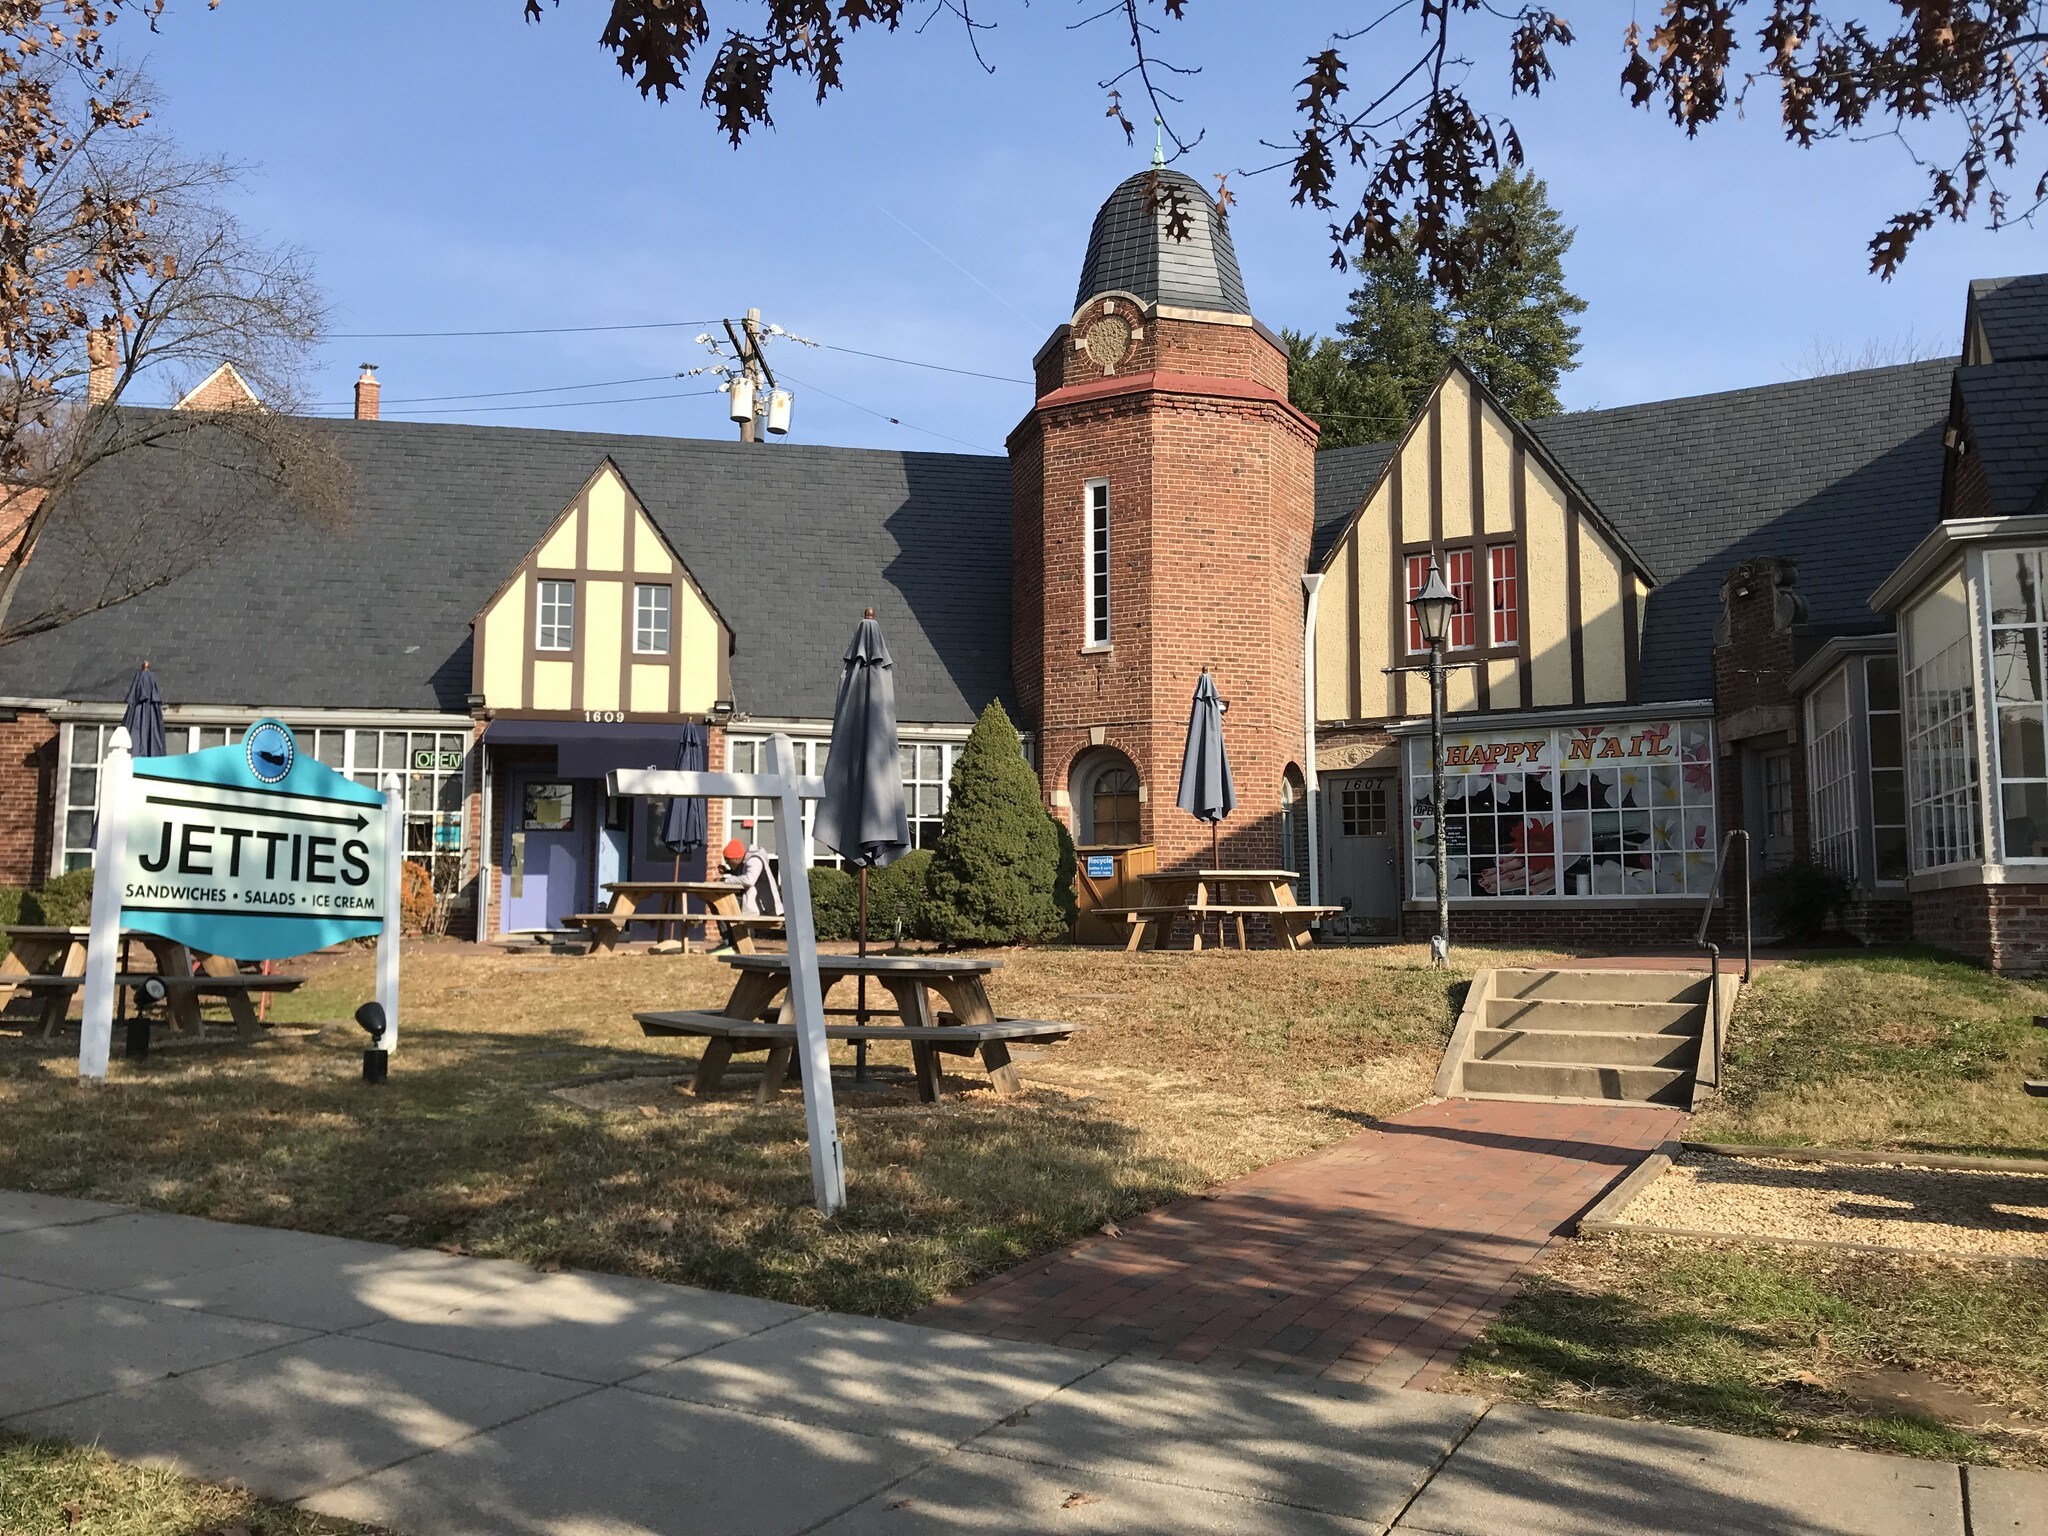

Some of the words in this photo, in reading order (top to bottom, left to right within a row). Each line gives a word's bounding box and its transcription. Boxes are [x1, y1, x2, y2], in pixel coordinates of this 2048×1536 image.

[1452, 582, 1504, 614] AIL
[585, 711, 625, 723] 1609
[1445, 741, 1546, 766] HAPPY
[1569, 734, 1673, 760] NAIL
[1344, 779, 1384, 791] 1607
[139, 821, 370, 886] JETTIES
[1088, 857, 1112, 866] Recycle
[125, 884, 226, 902] SANDWICHES
[244, 890, 296, 905] SALADS
[312, 894, 330, 907] ICE
[334, 895, 375, 910] CREAM
